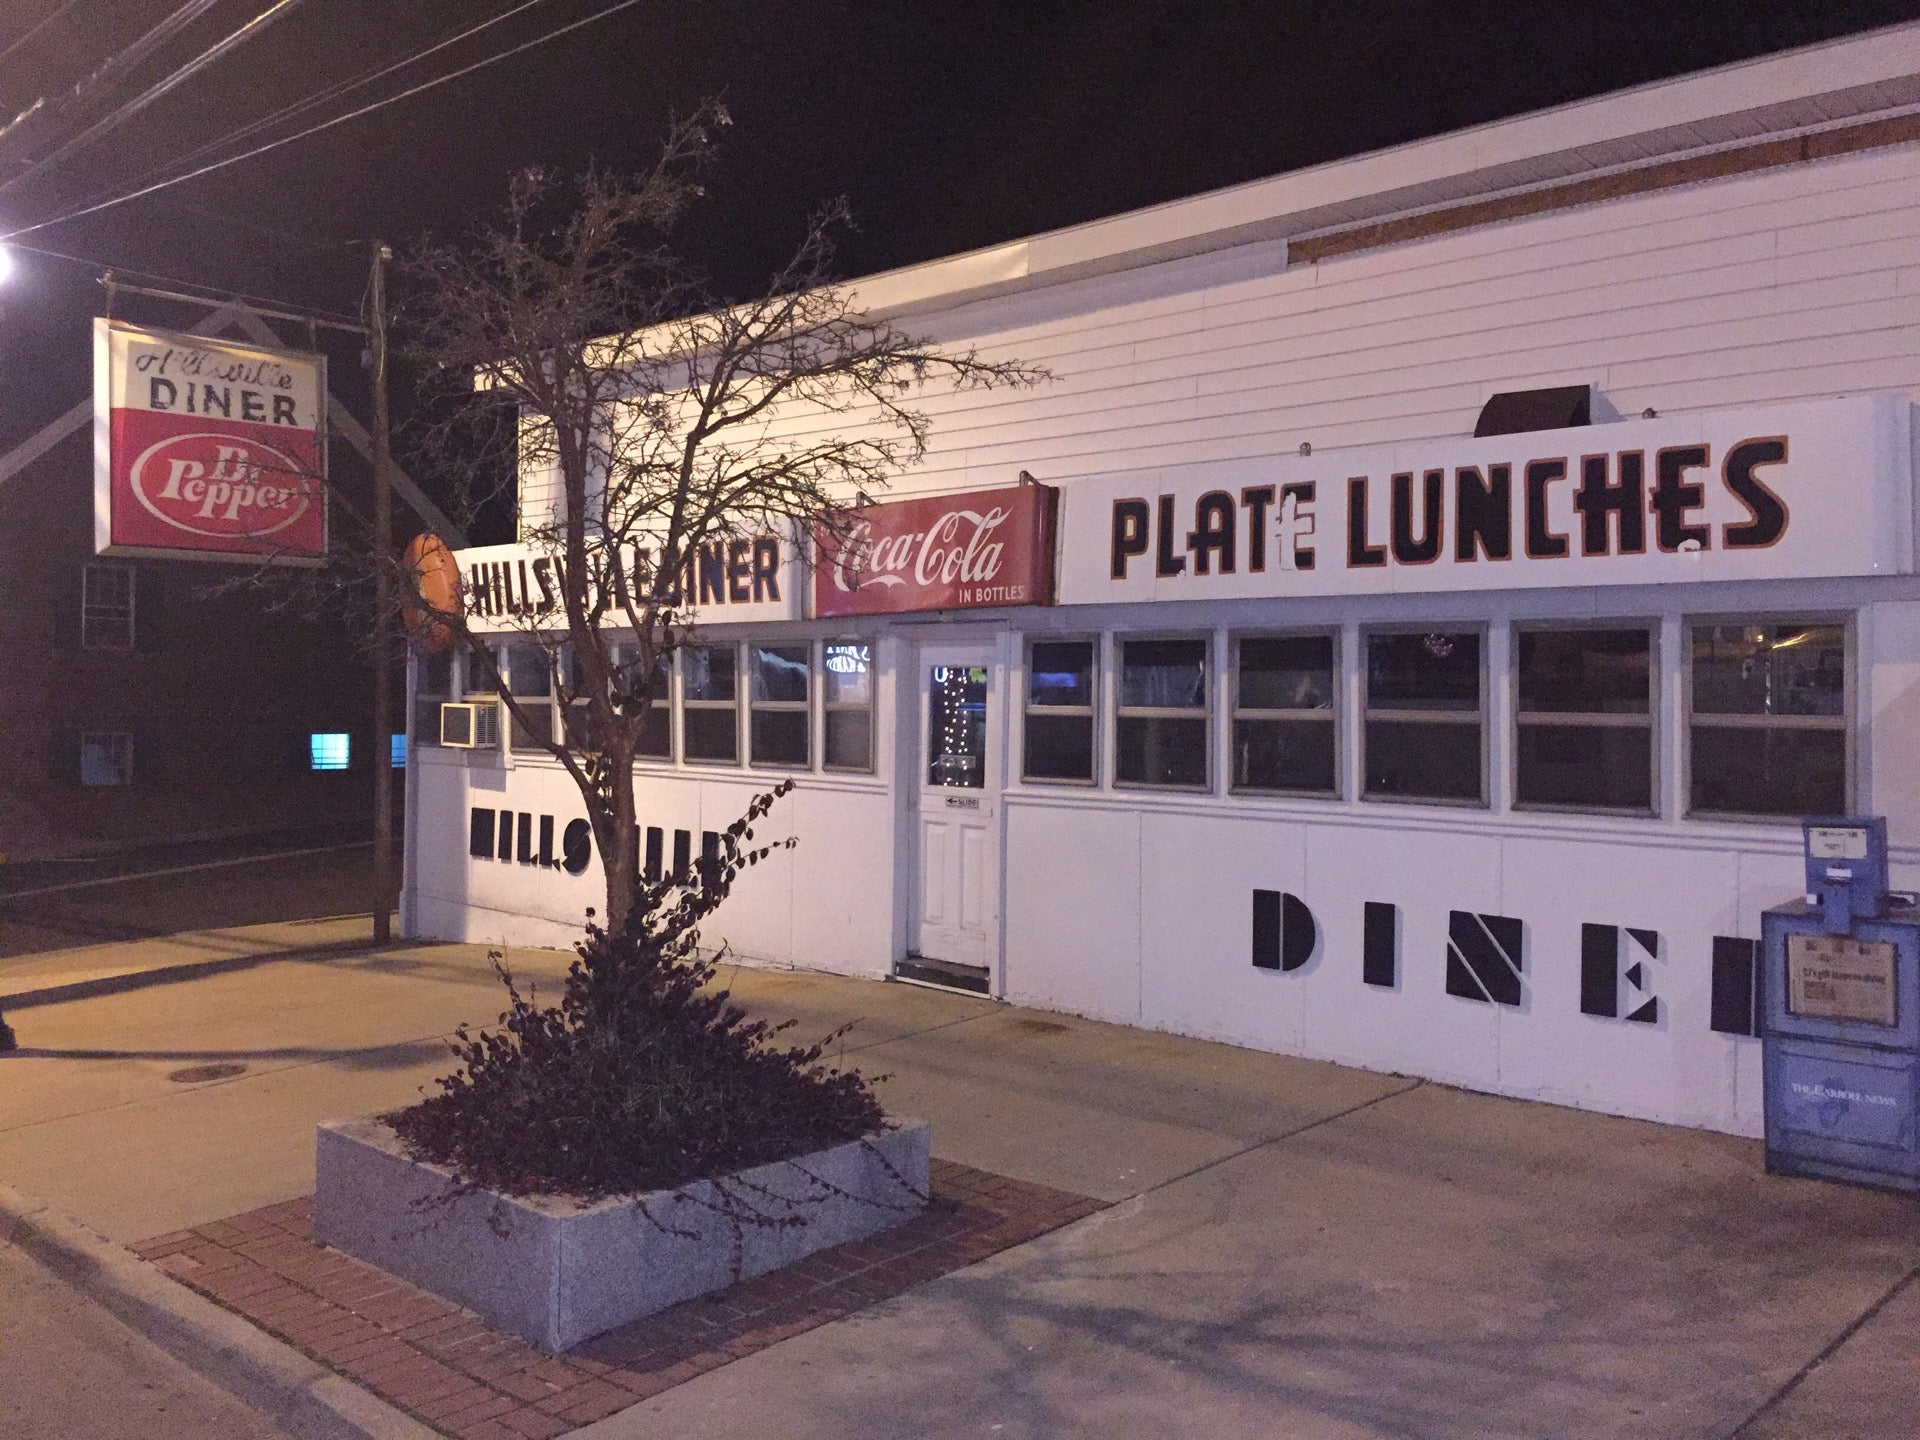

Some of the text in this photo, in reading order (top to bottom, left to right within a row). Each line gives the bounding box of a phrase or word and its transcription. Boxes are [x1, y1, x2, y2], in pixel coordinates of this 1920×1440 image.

[150, 376, 298, 426] DINER
[157, 458, 298, 520] Pepper
[209, 445, 261, 484] Dr
[1111, 435, 1790, 579] PLATE LUNCHES
[834, 506, 1013, 591] Coca-Cola
[959, 585, 1025, 603] IN BOTTLES
